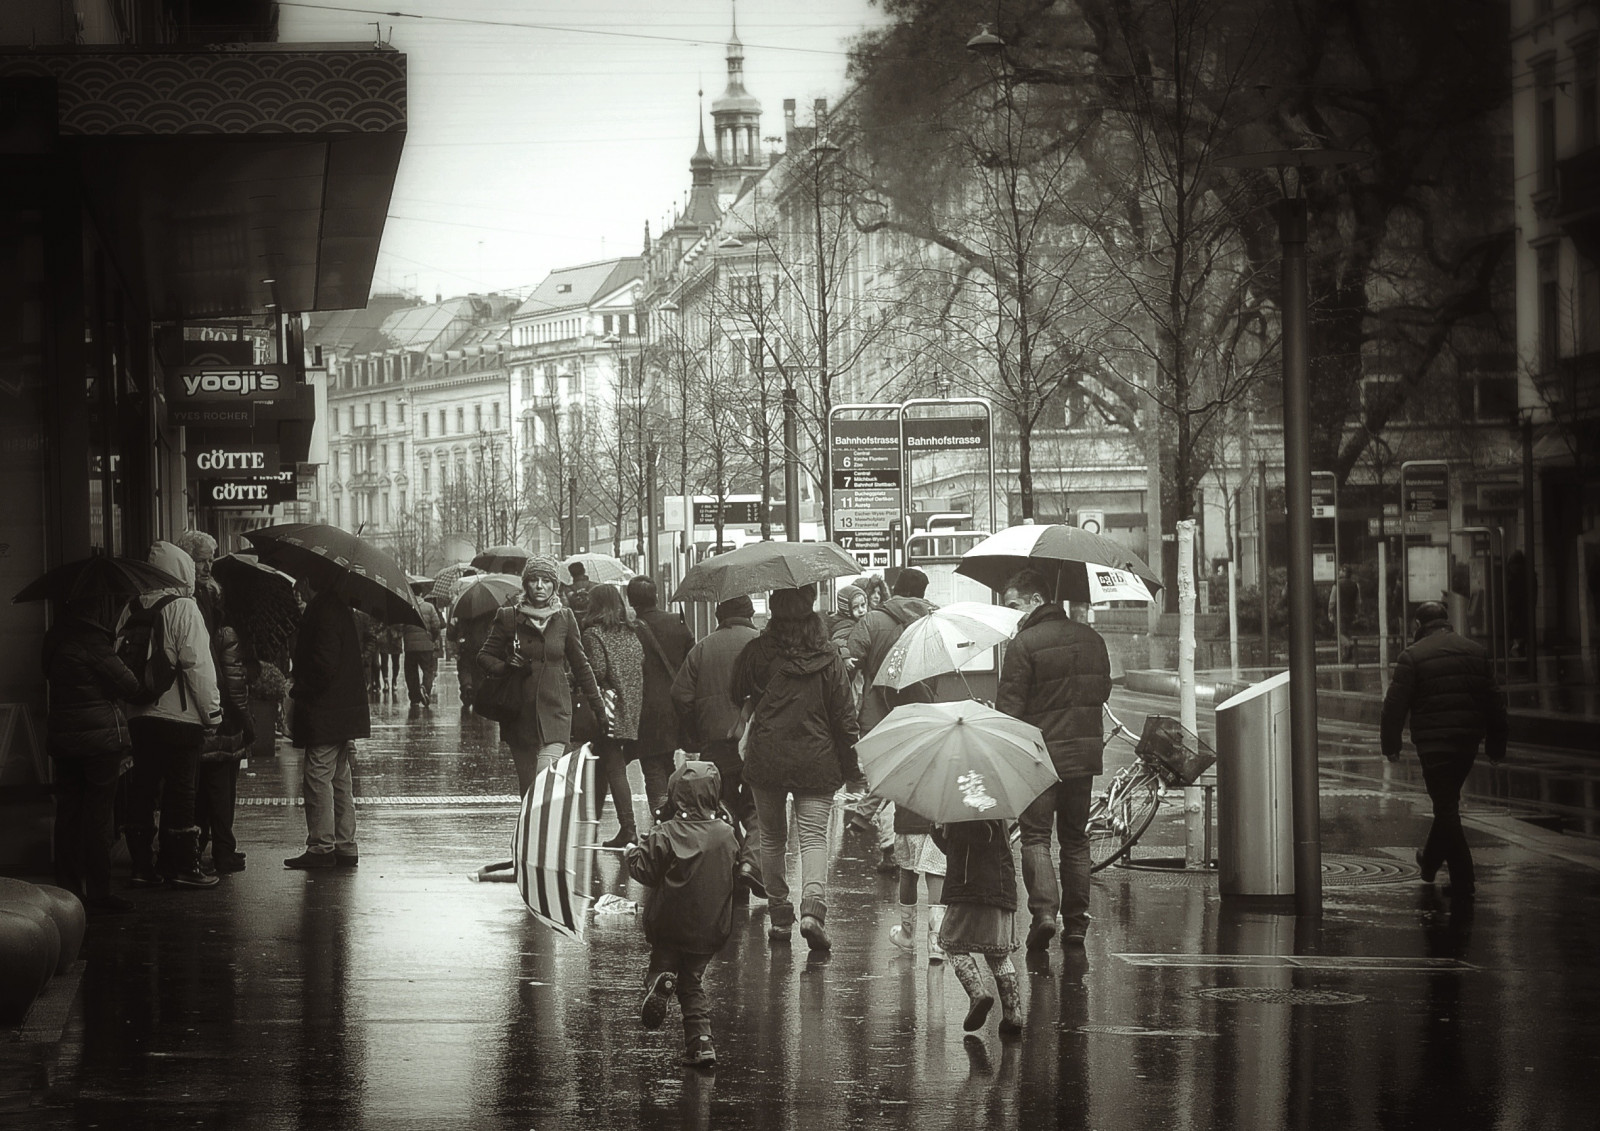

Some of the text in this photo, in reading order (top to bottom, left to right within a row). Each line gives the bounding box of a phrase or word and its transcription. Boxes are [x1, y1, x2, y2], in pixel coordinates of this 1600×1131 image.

[174, 412, 248, 420] YVES ROCHER
[835, 436, 899, 445] Bahnhofstrasse
[907, 436, 981, 446] Bahnhofstrasse
[197, 449, 264, 469] GÖTTE
[843, 456, 851, 468] 6
[843, 476, 851, 488] 7
[212, 483, 267, 500] GÖTTE
[840, 497, 852, 508] 11
[840, 517, 853, 528] 13
[840, 537, 853, 548] 17
